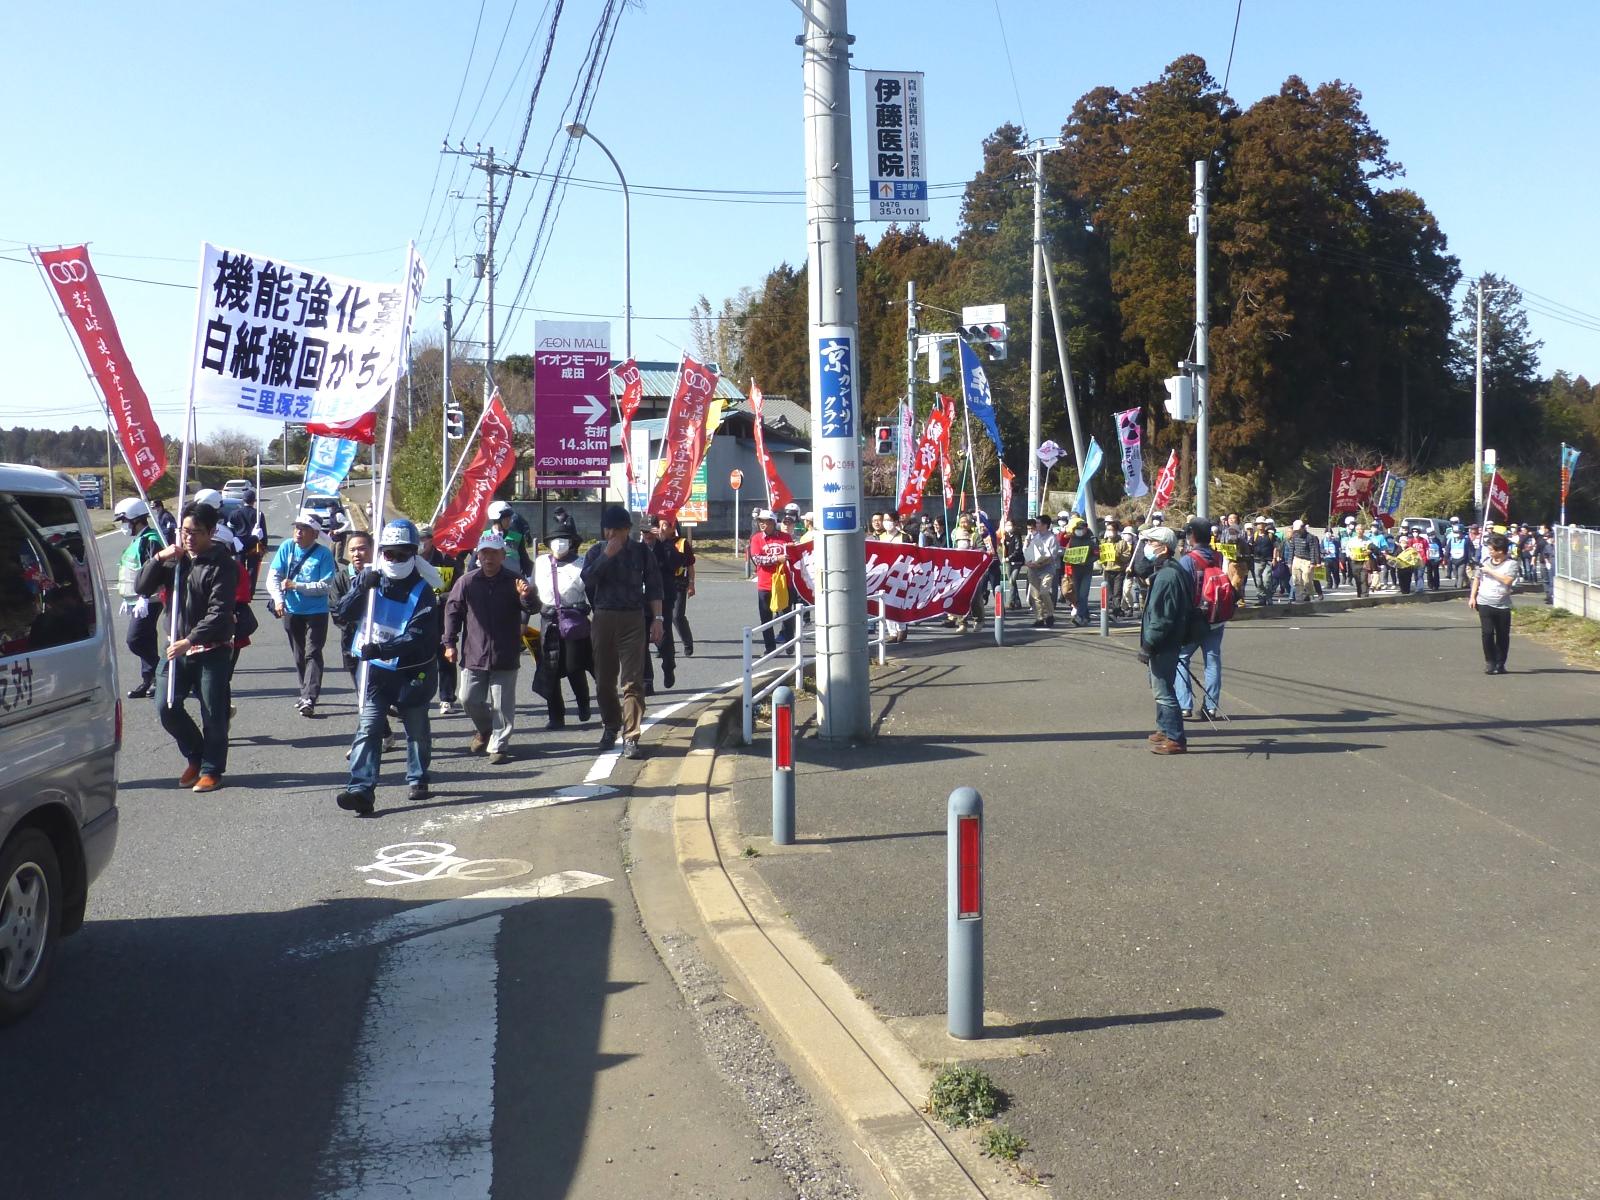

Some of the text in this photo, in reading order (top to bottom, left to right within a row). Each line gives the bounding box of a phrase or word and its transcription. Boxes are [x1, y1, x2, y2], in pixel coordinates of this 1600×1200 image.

[875, 78, 905, 178] 伊藤医院
[574, 338, 607, 349] MALL
[538, 354, 607, 366] イオンモール
[820, 340, 850, 373] 京
[561, 368, 585, 379] 成田
[838, 374, 851, 436] カントリー
[822, 396, 840, 436] クラブ
[584, 426, 607, 438] 右折
[559, 438, 608, 450] 14.3km
